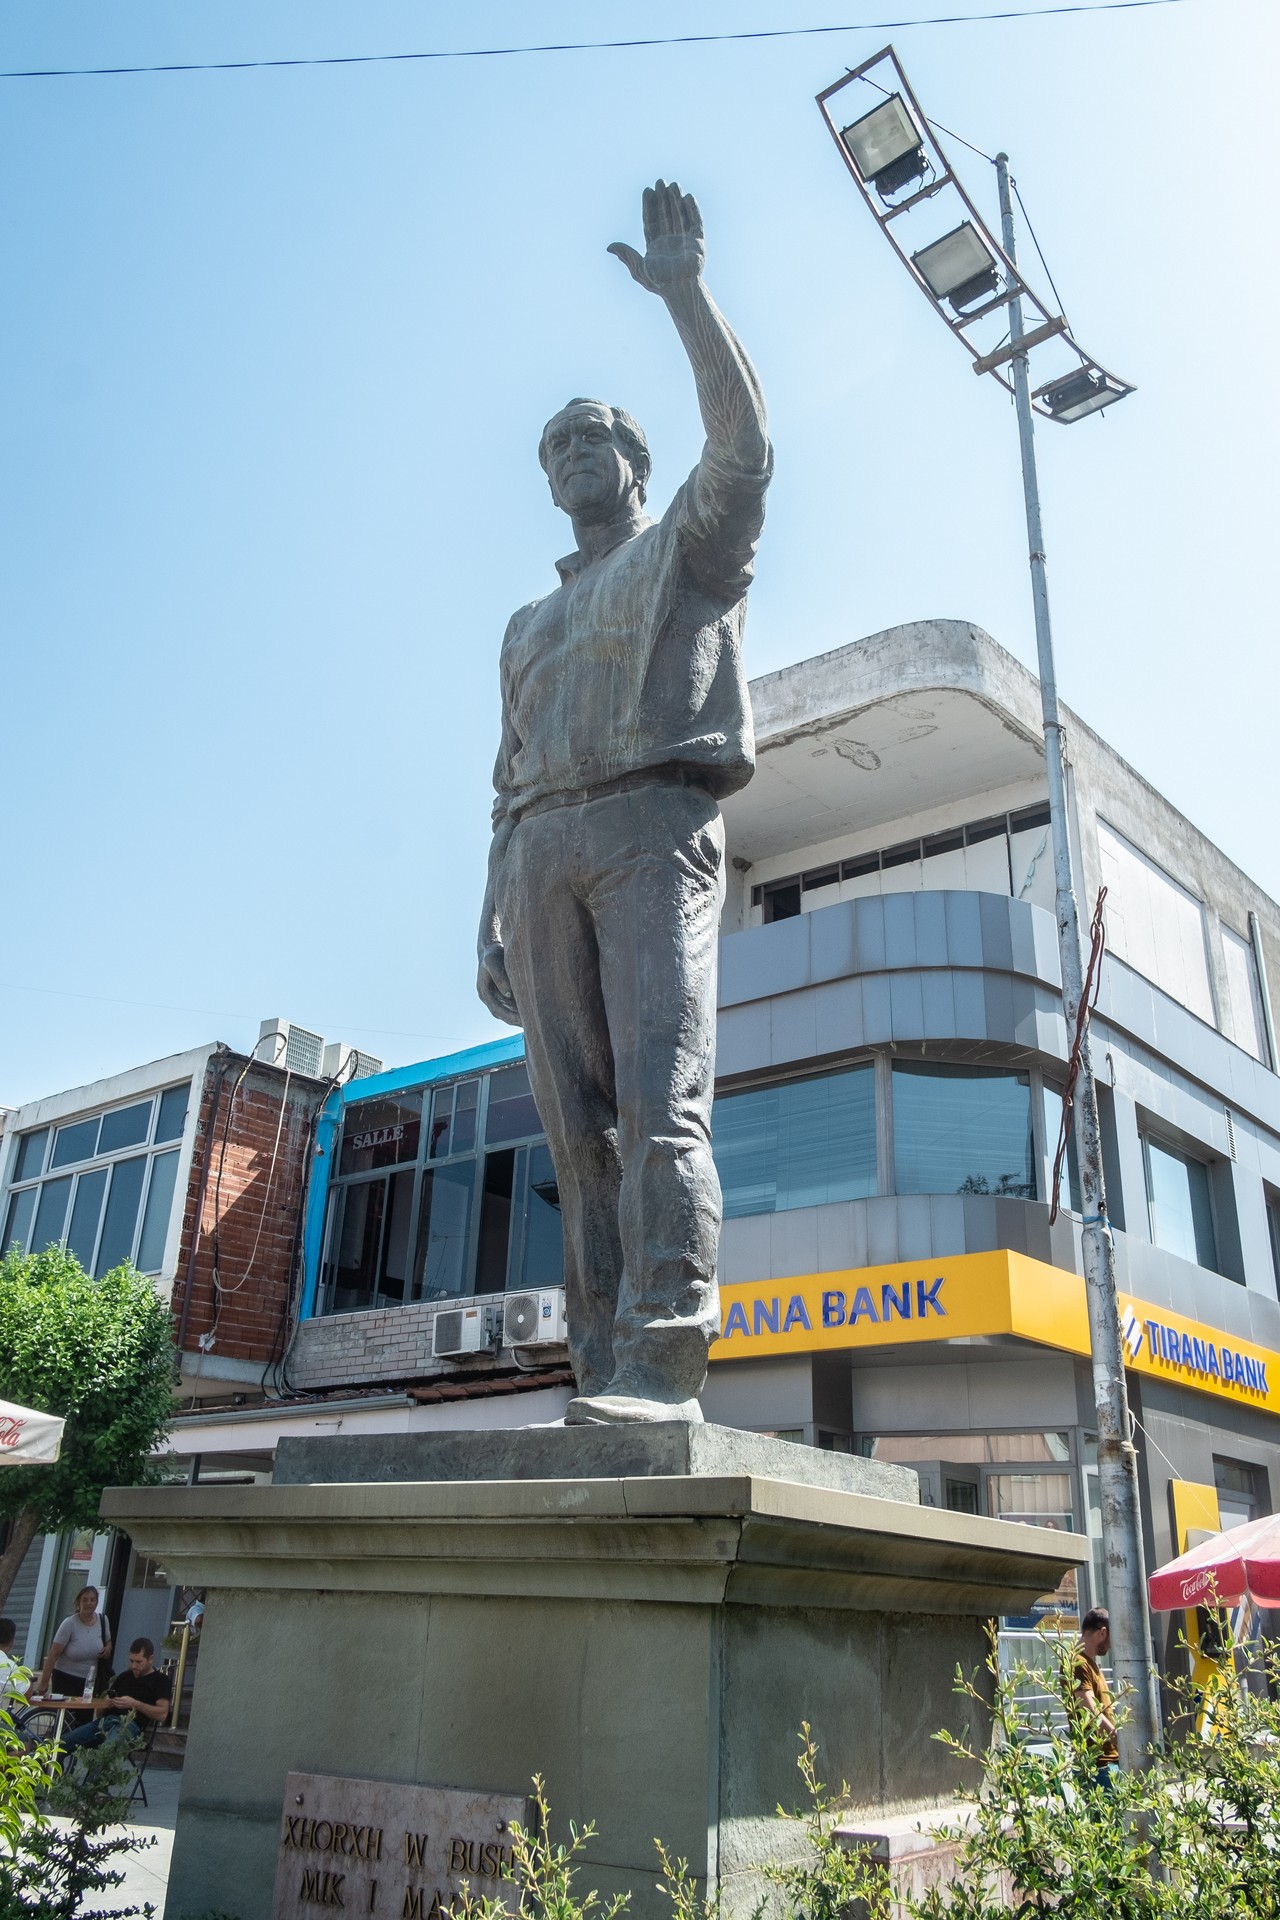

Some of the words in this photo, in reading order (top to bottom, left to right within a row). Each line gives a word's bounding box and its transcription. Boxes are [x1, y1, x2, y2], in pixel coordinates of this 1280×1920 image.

[353, 1125, 404, 1150] SALLE
[721, 1294, 813, 1339] ANA
[822, 1277, 948, 1329] BANK
[1144, 1319, 1221, 1377] TIRANA
[1220, 1347, 1270, 1393] BANK
[284, 1815, 383, 1860] XHORXH
[404, 1831, 428, 1866] W
[449, 1837, 515, 1878] BUSH
[300, 1867, 345, 1907] MIK
[368, 1879, 377, 1912] I
